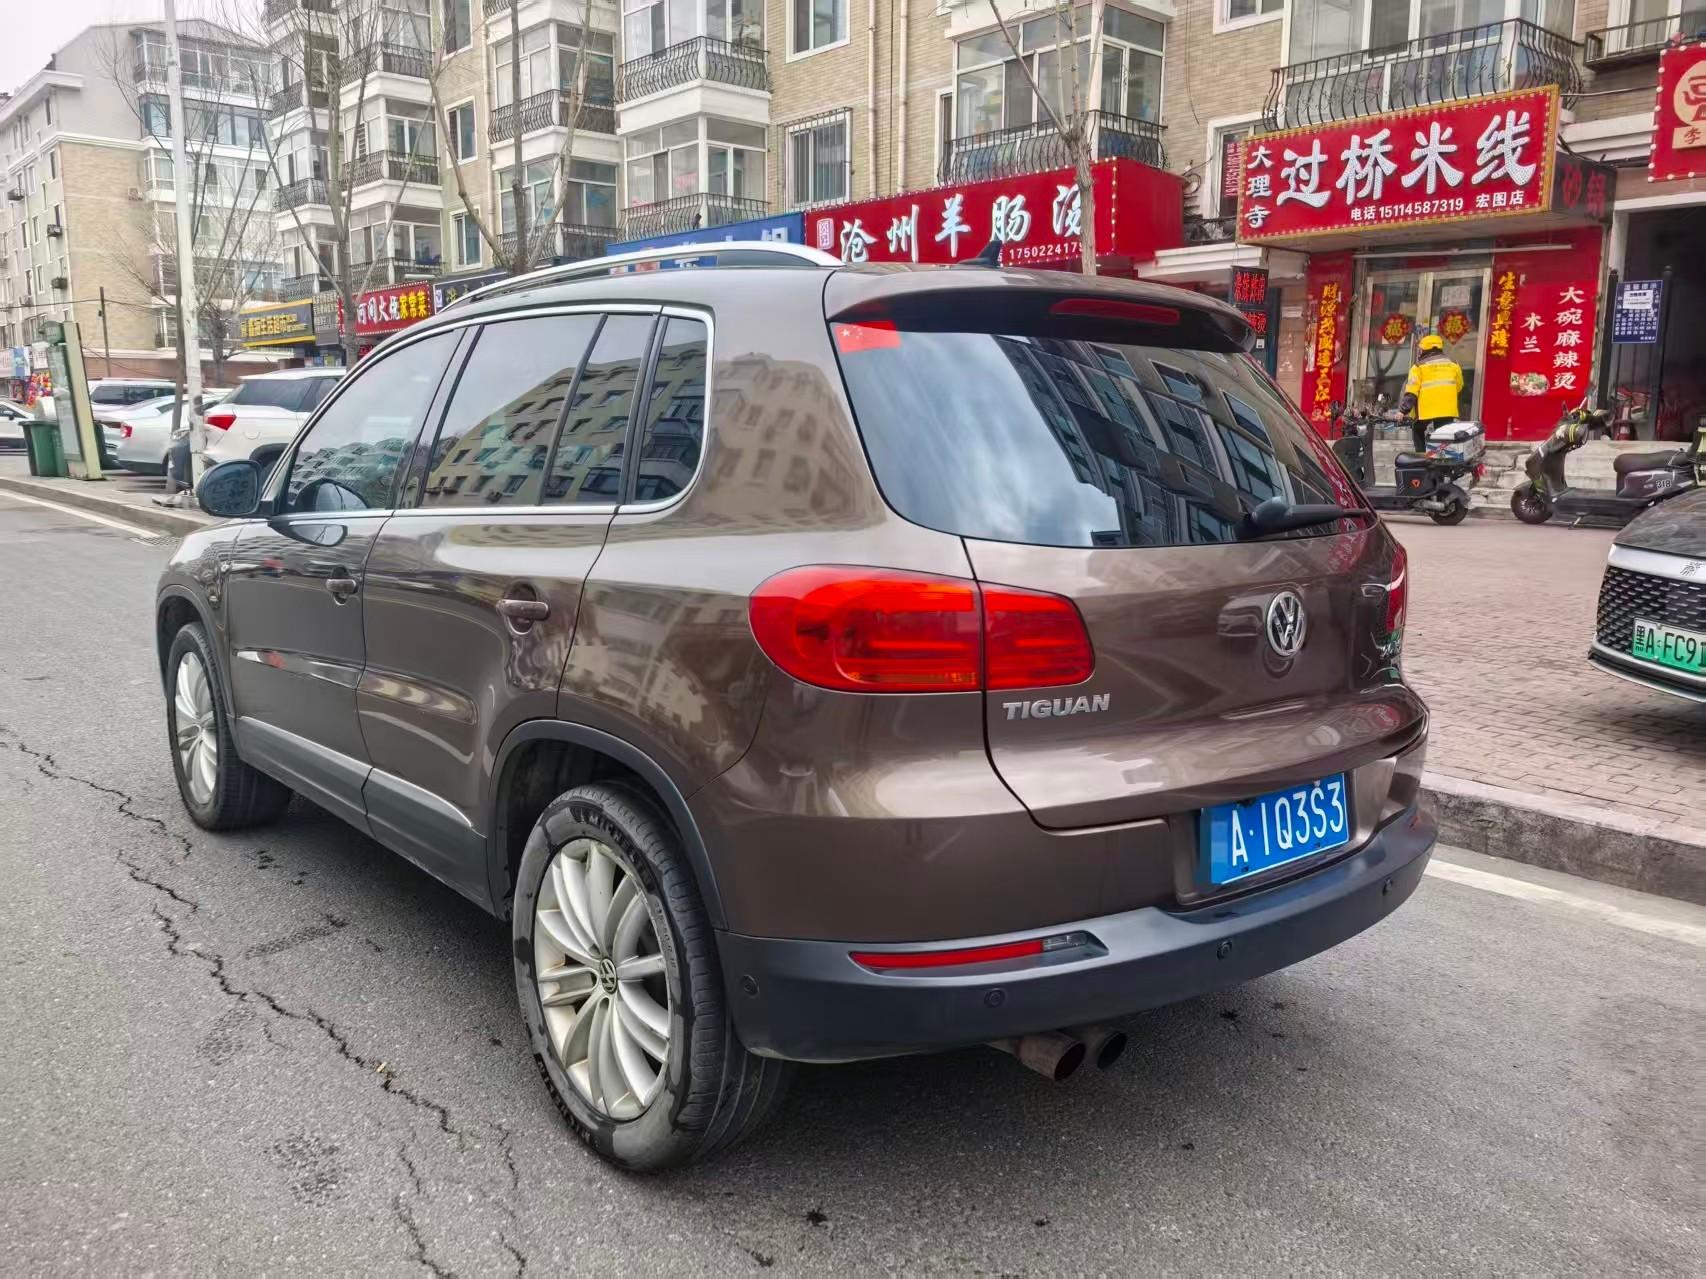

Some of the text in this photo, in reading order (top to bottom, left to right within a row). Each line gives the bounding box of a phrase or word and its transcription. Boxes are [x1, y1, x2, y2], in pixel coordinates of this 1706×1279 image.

[1275, 108, 1538, 208] 过桥米线
[1244, 144, 1274, 229] 大理寺
[1350, 190, 1525, 222] 电话 15114587319 宏图店
[1519, 311, 1545, 353] 木兰
[1550, 285, 1586, 390] 大碗麻辣烫
[1656, 480, 1671, 489] 318
[1002, 693, 1111, 721] TIGUAN
